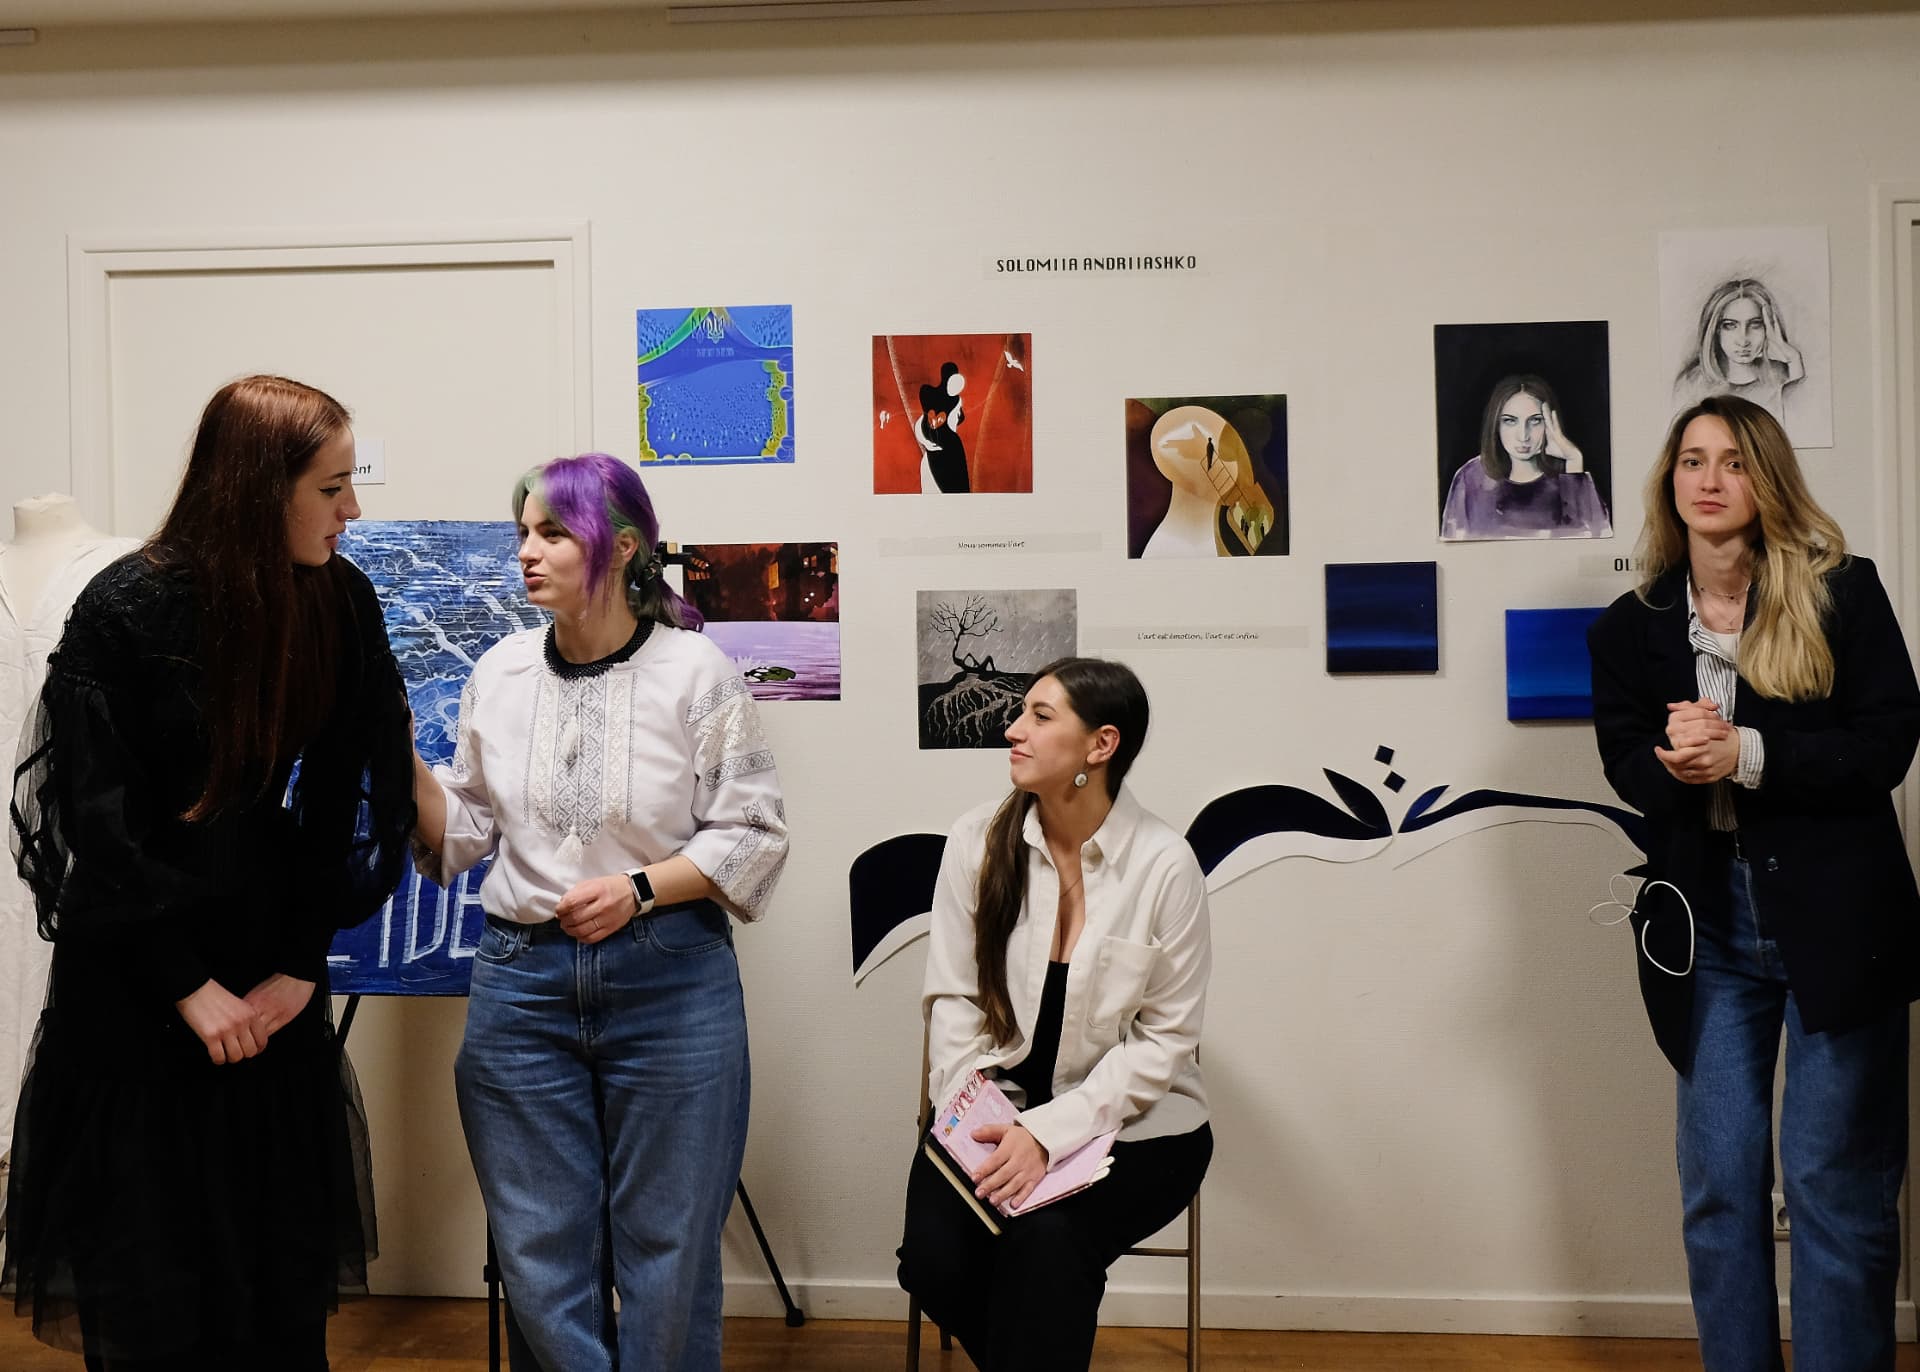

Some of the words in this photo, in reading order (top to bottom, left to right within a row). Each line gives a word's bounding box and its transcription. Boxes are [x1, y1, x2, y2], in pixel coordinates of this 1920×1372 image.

[997, 258, 1078, 273] SOLOMIIA
[1083, 255, 1197, 271] ANDRIIASHKO
[352, 463, 371, 475] ent
